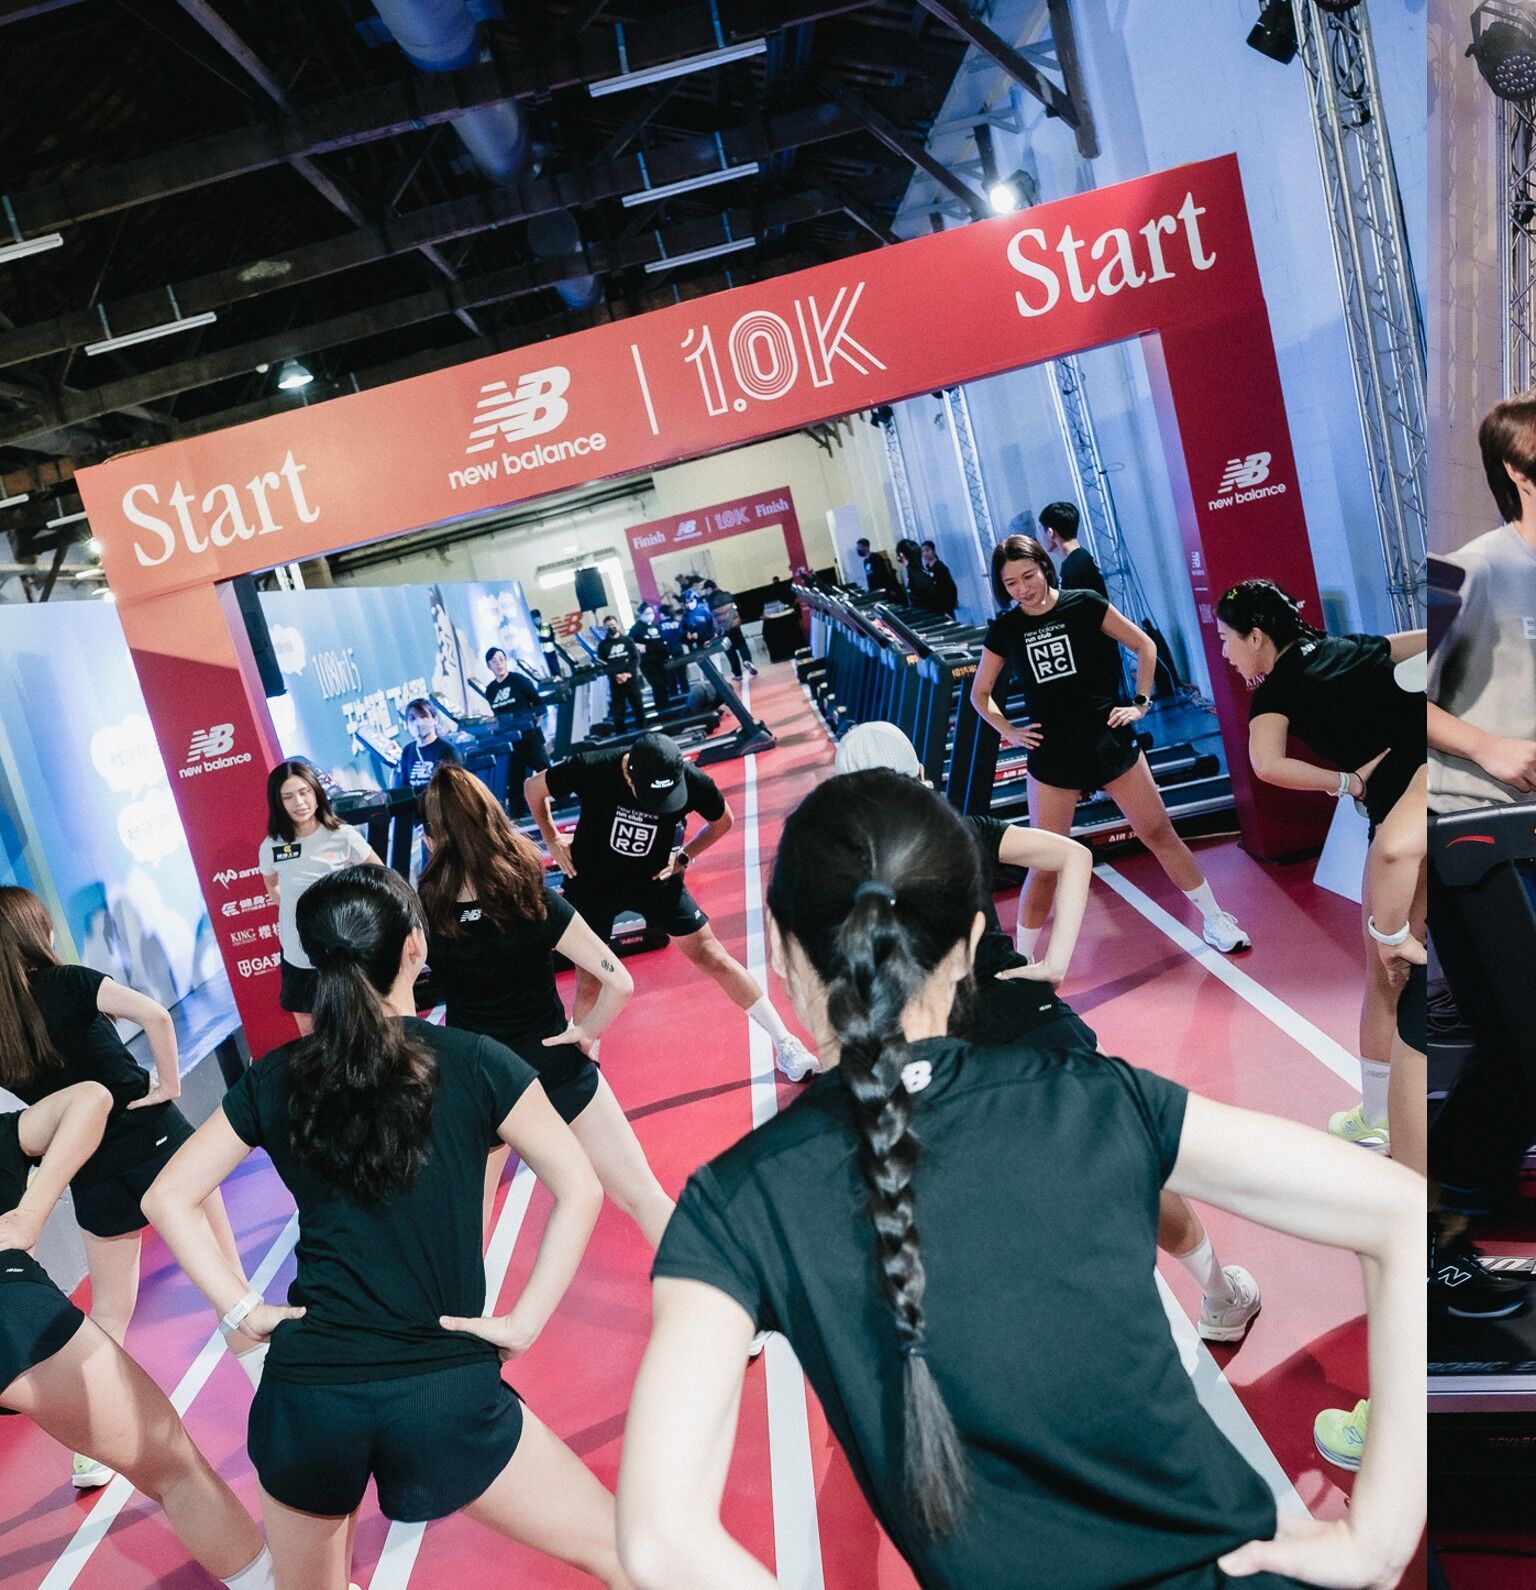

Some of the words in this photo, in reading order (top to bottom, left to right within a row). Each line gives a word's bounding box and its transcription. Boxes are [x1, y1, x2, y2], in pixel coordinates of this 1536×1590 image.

[1007, 191, 1217, 318] Start
[681, 281, 888, 416] 1.0K
[466, 365, 571, 454] NB
[448, 461, 499, 490] new
[502, 432, 607, 476] balance
[1217, 451, 1271, 494] NB
[122, 449, 321, 567] Start
[1208, 496, 1234, 511] new
[1235, 483, 1287, 504] balance
[633, 531, 667, 550] Finish
[755, 498, 790, 518] Finish
[1025, 636, 1037, 644] run
[1037, 632, 1052, 641] club
[1033, 642, 1065, 661] NB
[1037, 657, 1069, 677] RC
[187, 723, 235, 763] NB
[179, 763, 203, 779] new
[203, 752, 252, 773] balance
[615, 837, 646, 853] RC
[618, 824, 649, 841] NB
[1108, 832, 1126, 843] AIR
[460, 908, 482, 923] NB
